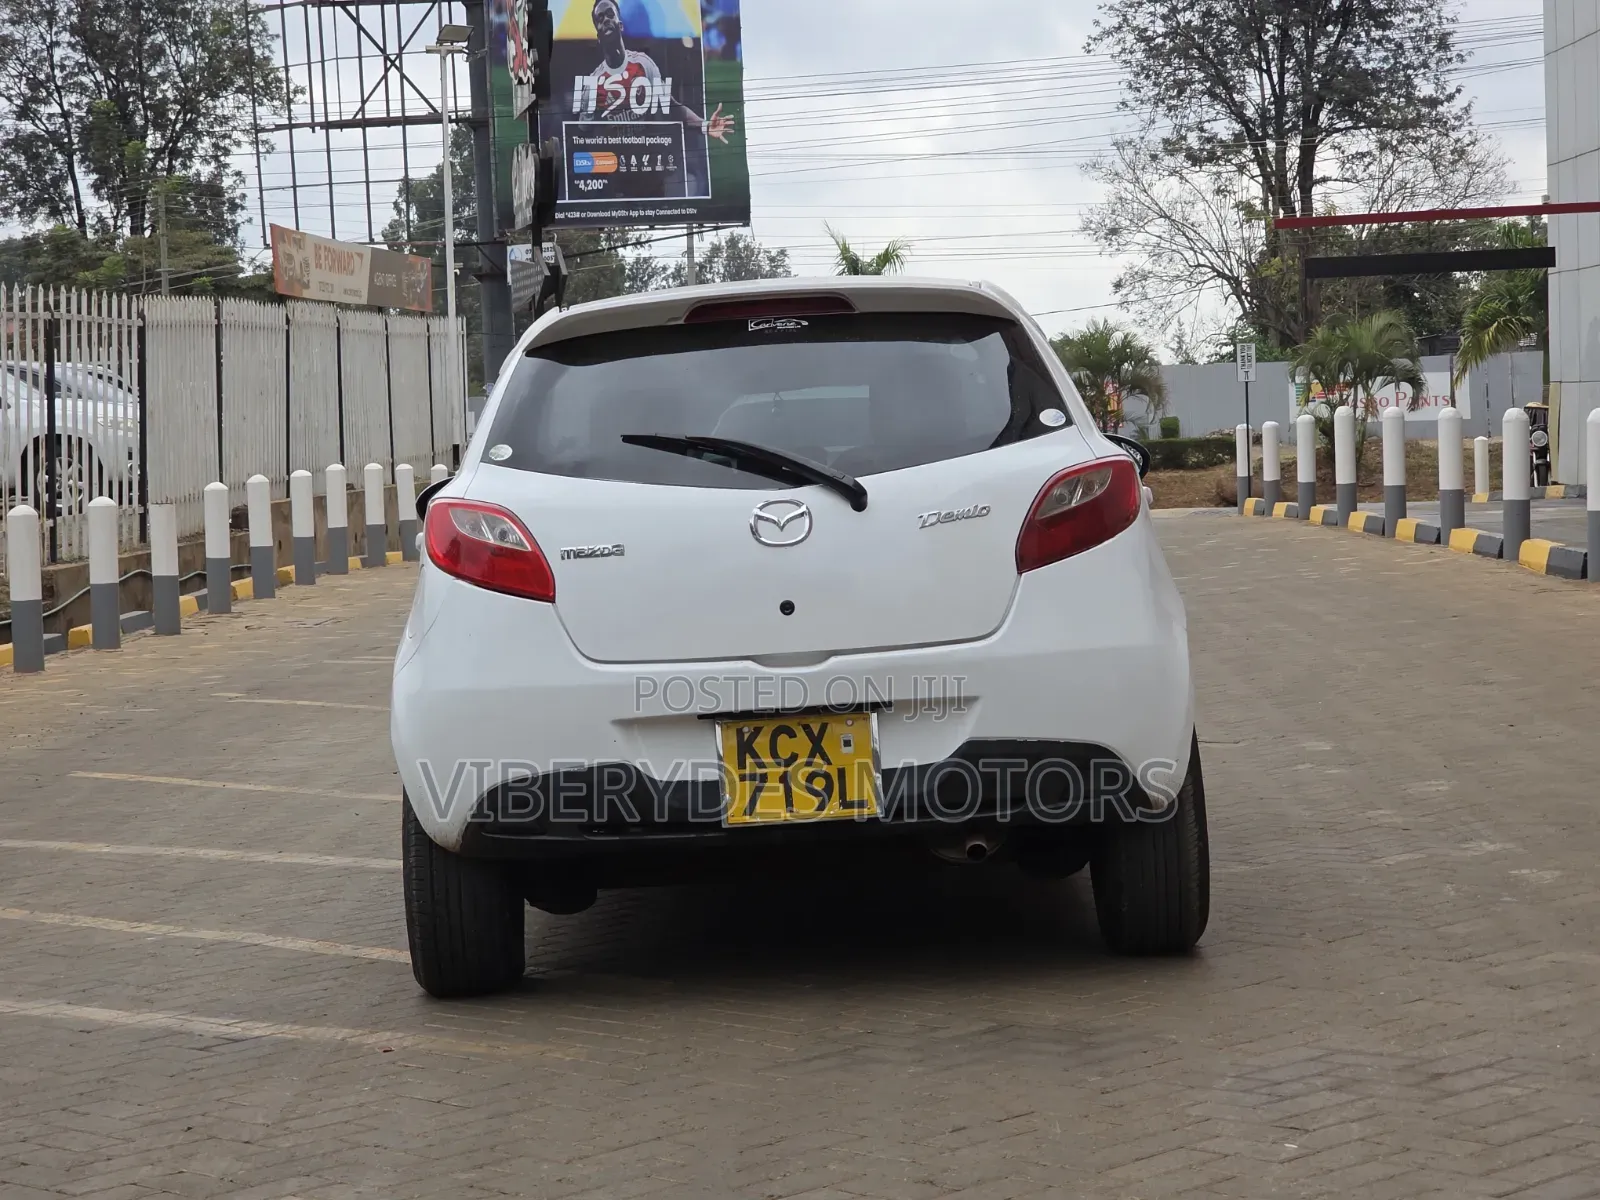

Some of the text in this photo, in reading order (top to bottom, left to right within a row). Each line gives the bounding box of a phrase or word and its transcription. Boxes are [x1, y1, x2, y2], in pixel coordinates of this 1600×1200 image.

[572, 71, 673, 118] IT'S ON
[572, 135, 672, 147] The world's best football package
[587, 210, 611, 218] Download
[629, 209, 639, 220] App
[645, 209, 655, 218] stay
[656, 207, 681, 216] Connected
[314, 242, 323, 270] BE
[324, 245, 355, 276] FORWARD
[1395, 391, 1450, 408] PANTS
[918, 503, 991, 529] Demio
[560, 543, 625, 560] mazda
[735, 722, 833, 771] KCX
[738, 767, 869, 817] 719L
